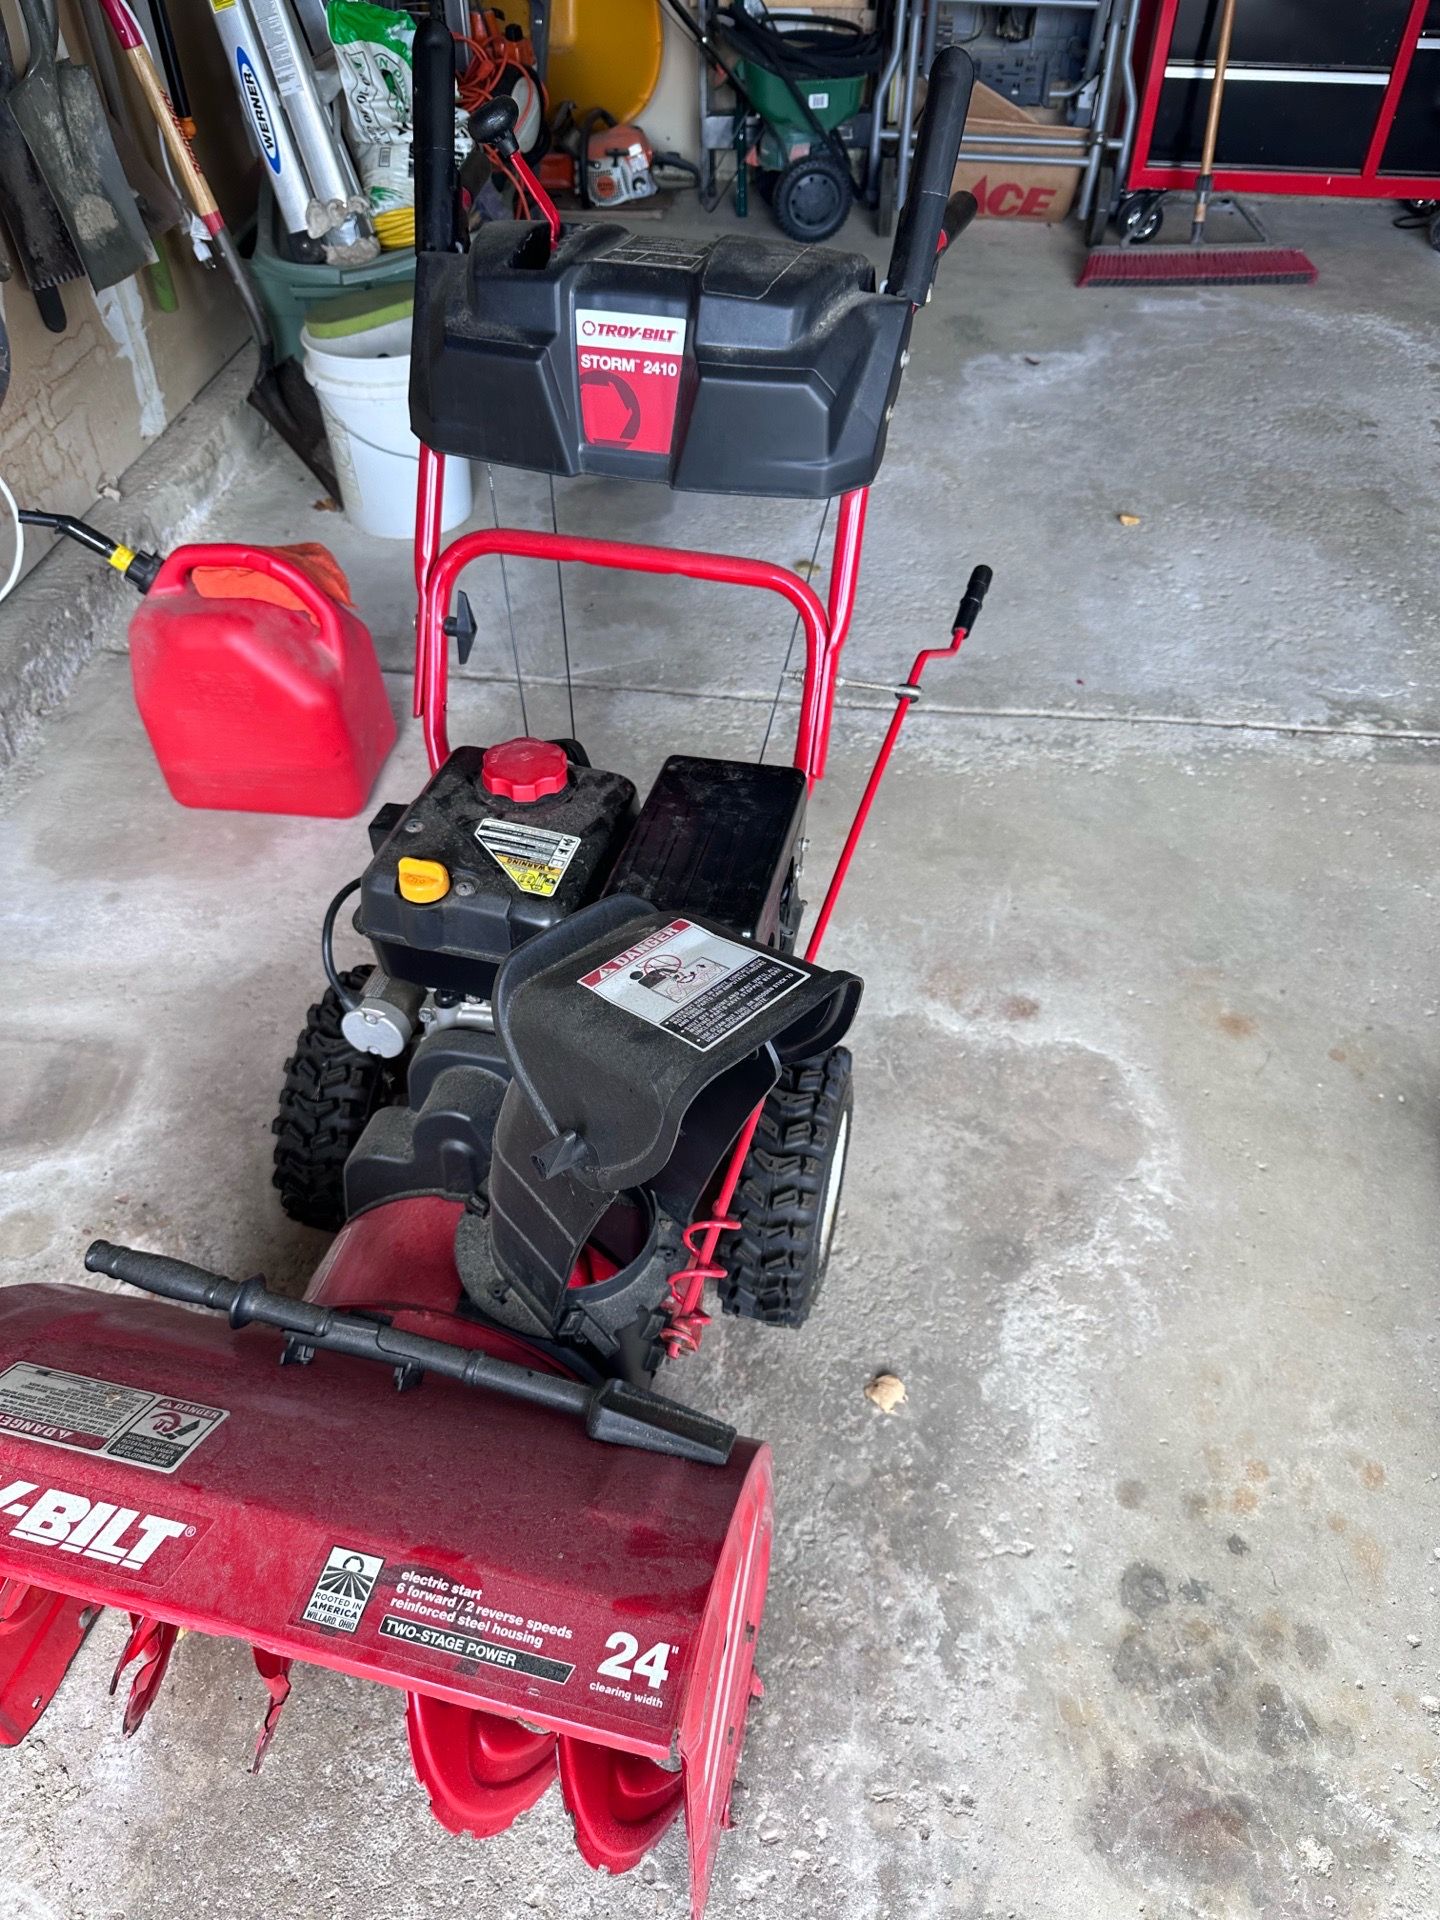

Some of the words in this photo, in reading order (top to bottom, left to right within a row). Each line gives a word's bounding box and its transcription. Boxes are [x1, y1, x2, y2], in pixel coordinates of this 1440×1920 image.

[243, 72, 274, 150] WERNER
[970, 176, 1057, 217] ACE
[597, 323, 677, 343] TROY-BILT
[643, 361, 677, 377] 2410
[507, 858, 546, 870] WARNING
[613, 927, 680, 966] DANGER
[174, 1401, 220, 1419] DANGER
[402, 1571, 449, 1591] electric
[451, 1583, 482, 1600] start
[310, 1601, 357, 1619] AMERICA
[315, 1592, 350, 1606] ROOTED
[352, 1602, 362, 1610] IN
[396, 1583, 406, 1594] 6
[407, 1585, 455, 1608] forward
[456, 1598, 463, 1610] /
[465, 1601, 475, 1612] 2
[476, 1606, 524, 1626] reverse
[526, 1618, 573, 1639] speeds
[338, 1619, 355, 1630] OHIO
[390, 1597, 454, 1622] reinforced
[458, 1615, 490, 1632] steel
[491, 1622, 543, 1648] housing
[386, 1619, 464, 1652] TWO-STAGE
[466, 1642, 517, 1667] POWER
[597, 1631, 679, 1689] 24"
[589, 1682, 632, 1701] clearing
[634, 1693, 663, 1708] width
